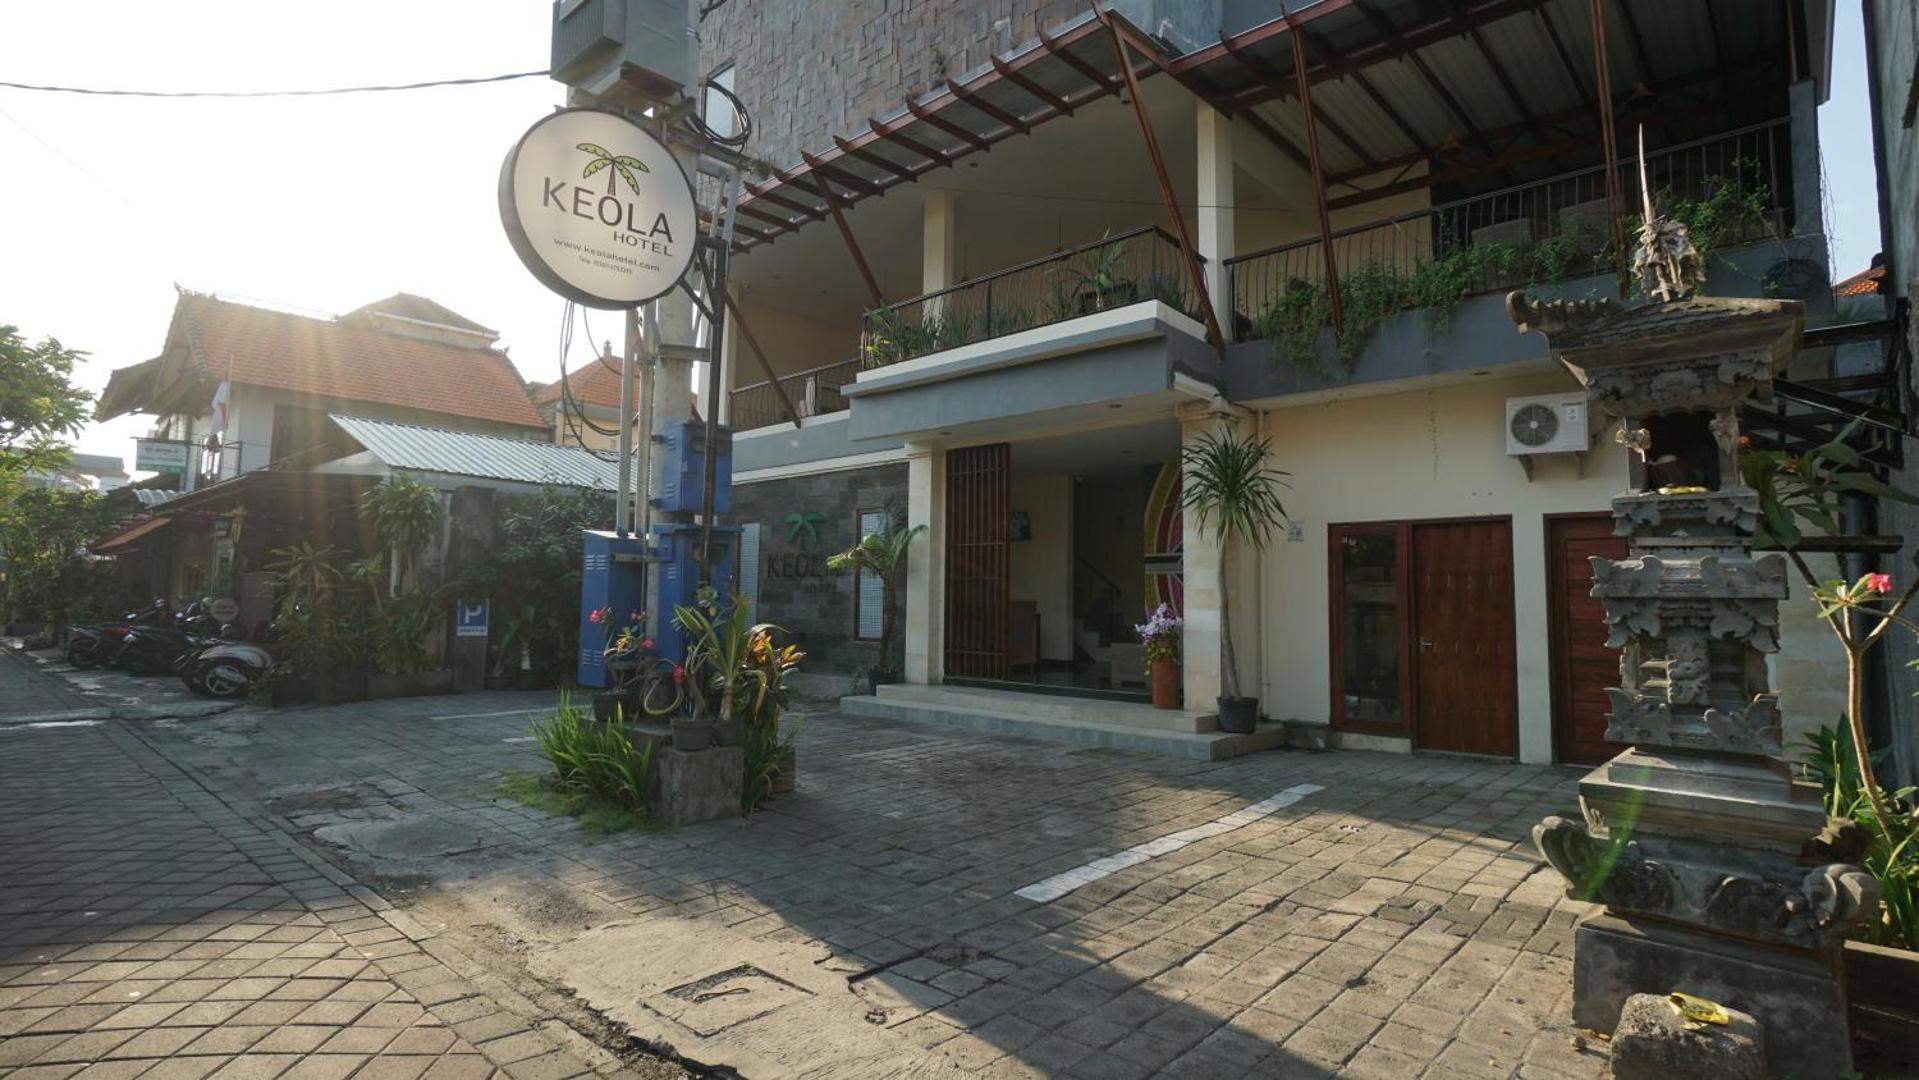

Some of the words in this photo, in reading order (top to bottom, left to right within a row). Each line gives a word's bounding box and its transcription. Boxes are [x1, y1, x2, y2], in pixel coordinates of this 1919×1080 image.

[543, 177, 673, 244] KEOLA
[613, 231, 673, 257] HOTEL
[767, 552, 839, 578] KEOL
